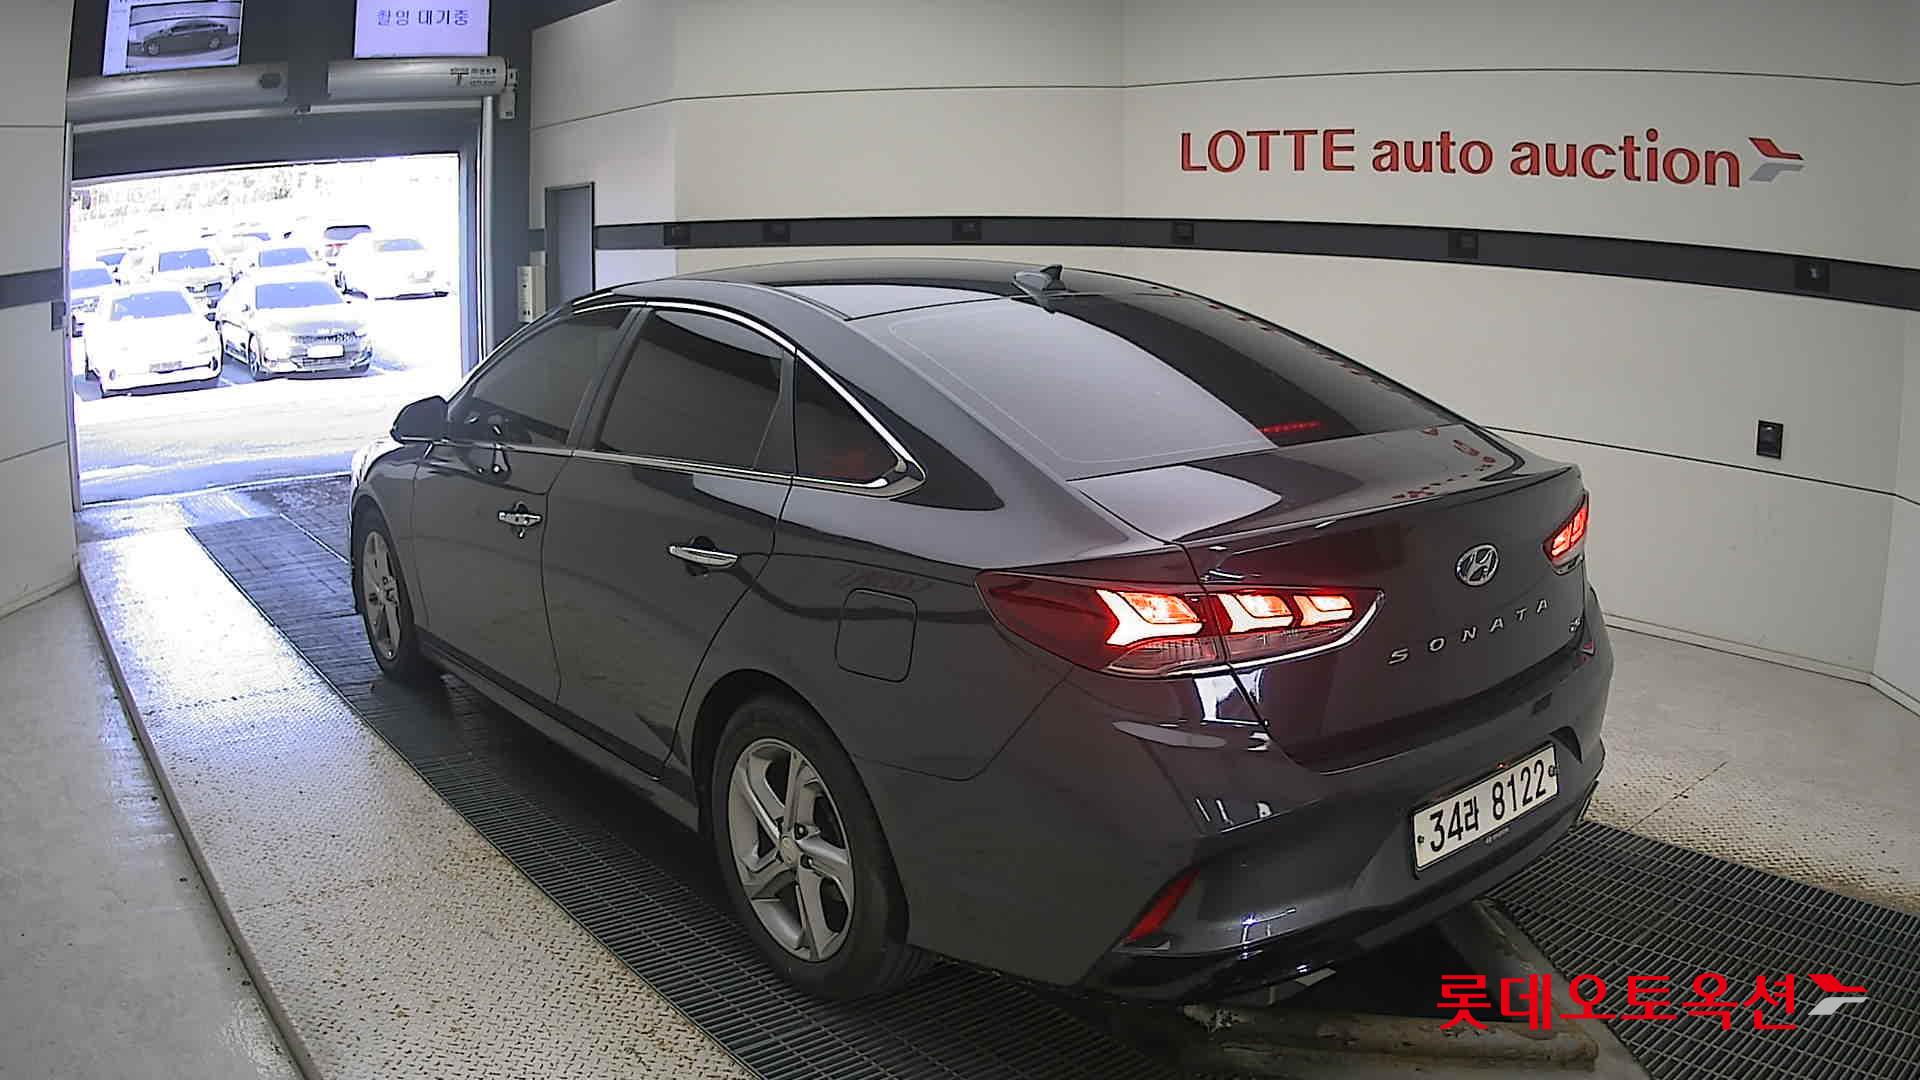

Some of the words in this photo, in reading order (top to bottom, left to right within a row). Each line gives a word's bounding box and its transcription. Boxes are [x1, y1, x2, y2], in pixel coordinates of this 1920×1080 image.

[417, 9, 470, 26] 대기중
[1181, 129, 1357, 173] LOTTE
[1372, 131, 1494, 174] auto
[1510, 129, 1741, 187] auction
[1388, 599, 1550, 665] SONATA
[1429, 796, 1480, 853] 34라
[1491, 760, 1547, 821] 8122
